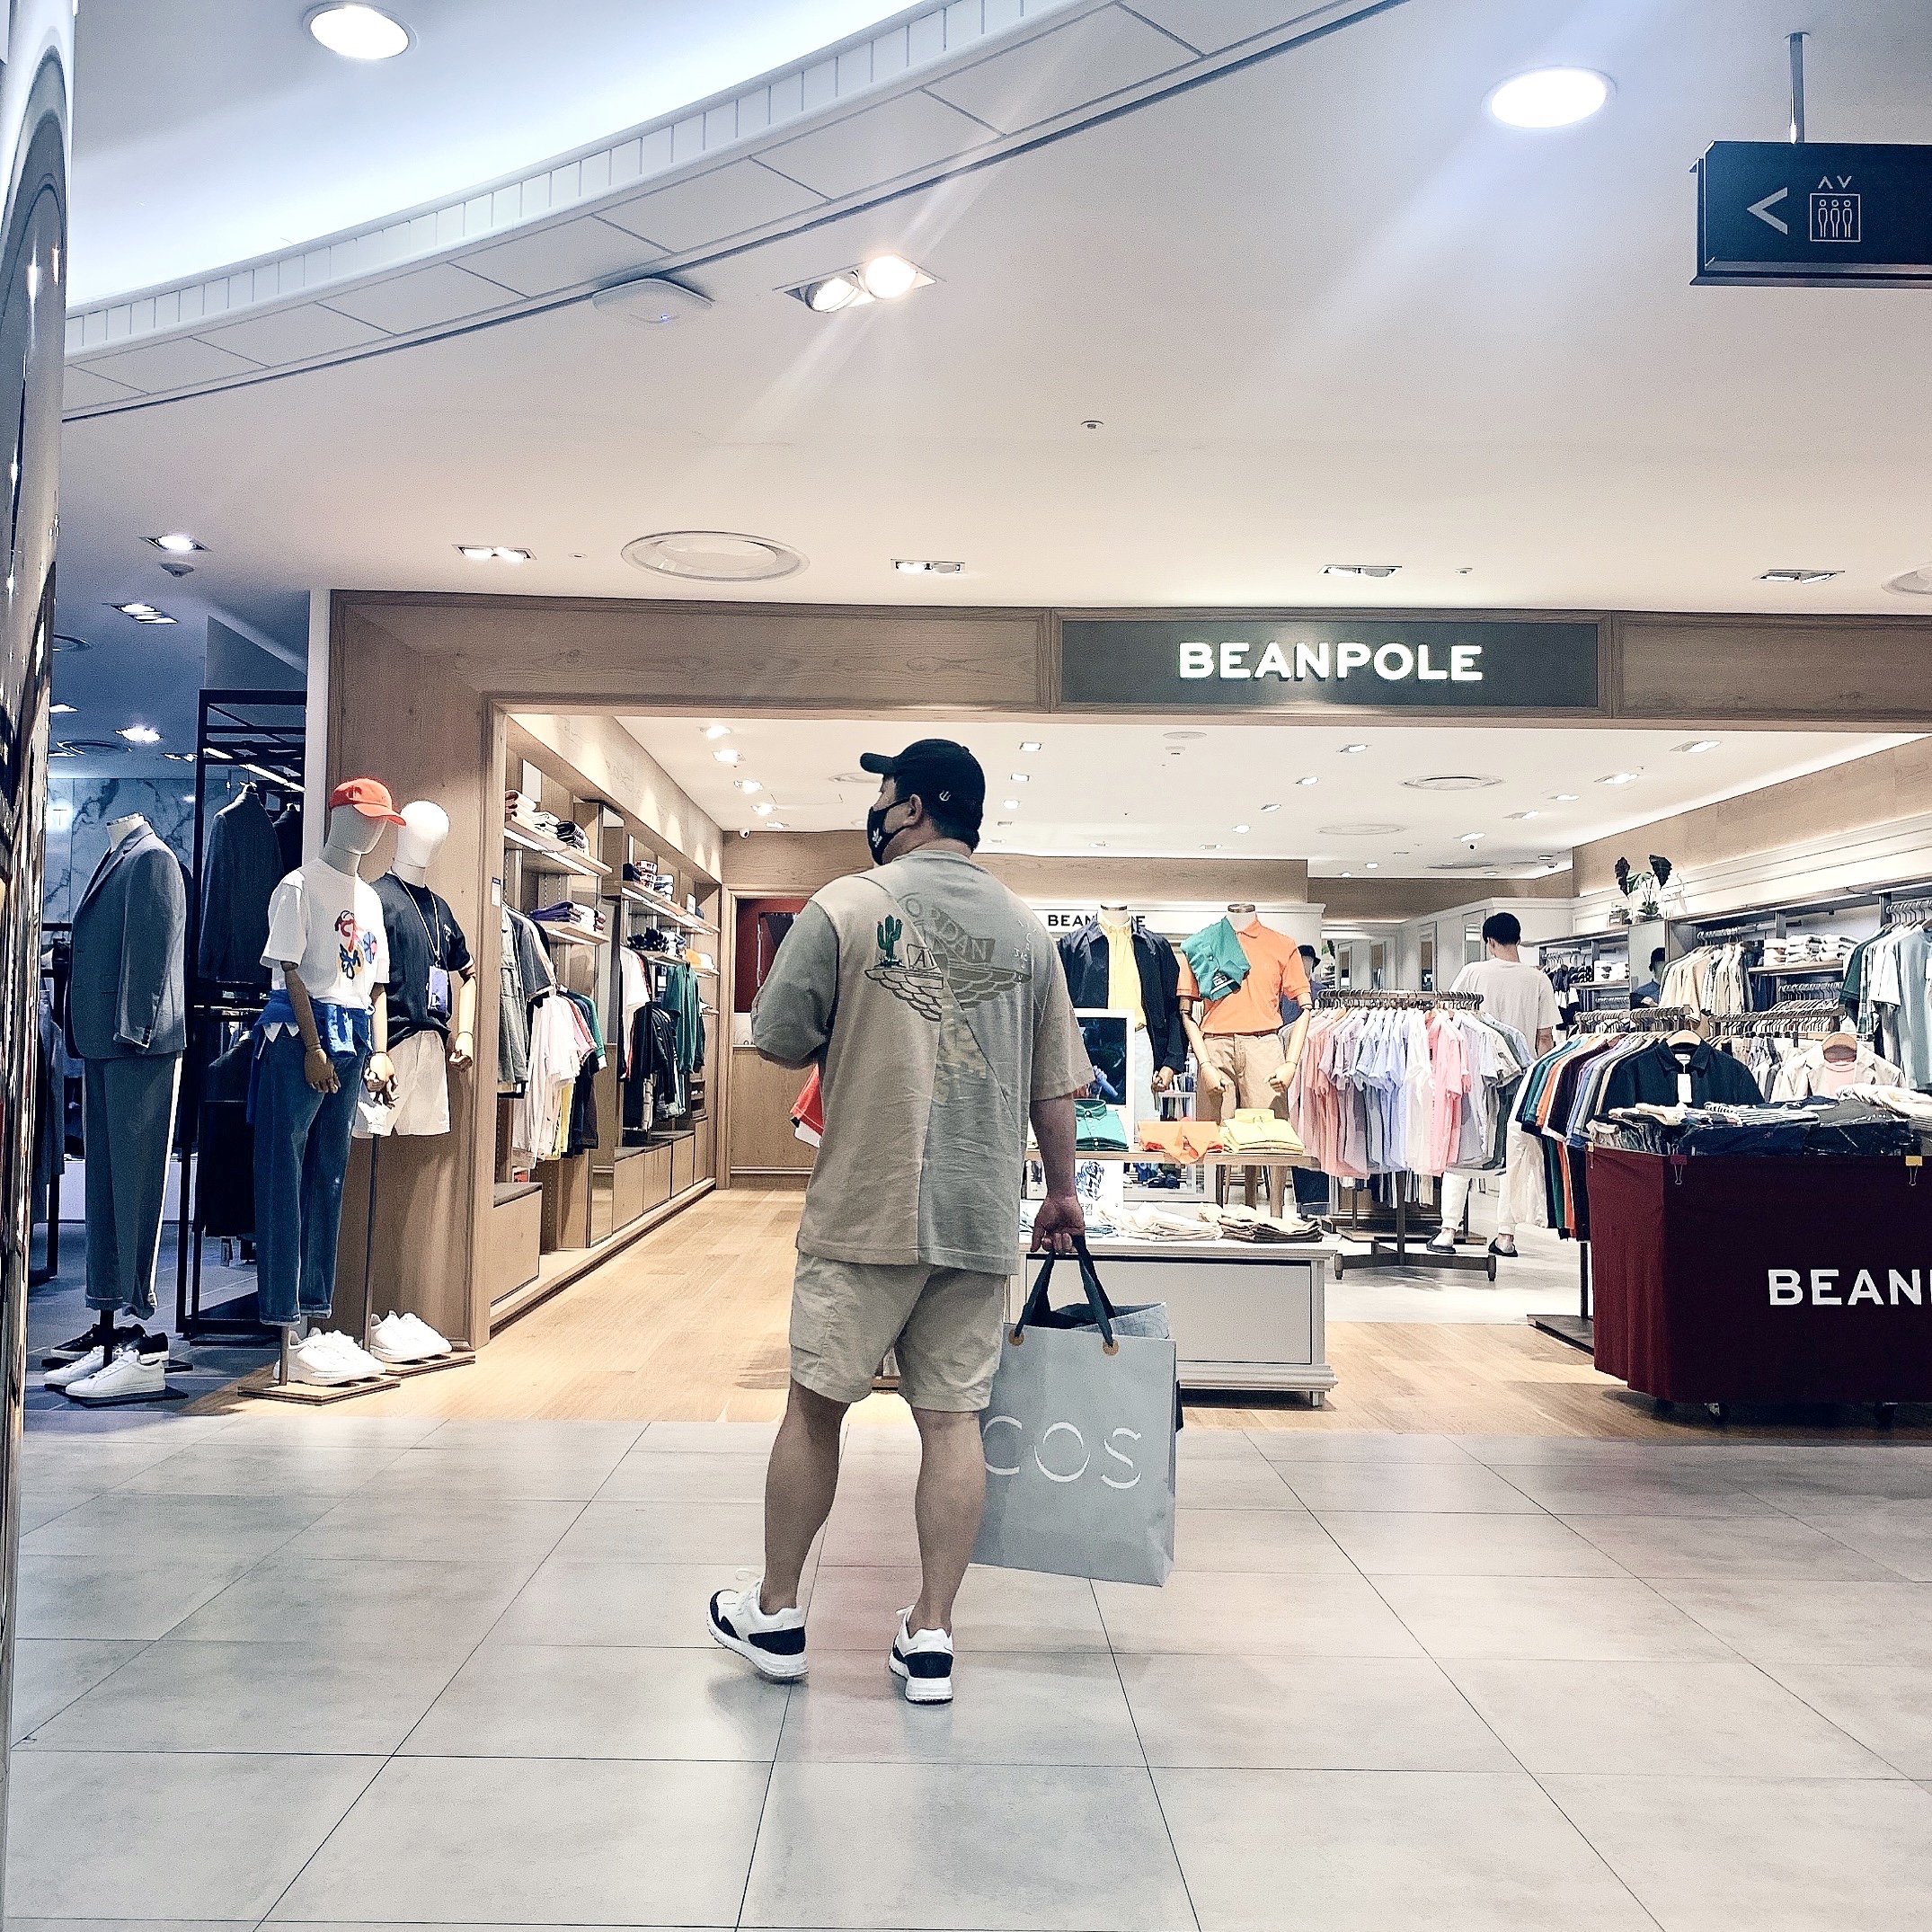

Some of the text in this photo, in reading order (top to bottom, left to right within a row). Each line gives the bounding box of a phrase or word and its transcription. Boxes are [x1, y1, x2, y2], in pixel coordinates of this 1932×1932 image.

[1178, 641, 1484, 681] BEANPOLE
[1768, 1268, 1932, 1306] BEAN
[982, 1414, 1142, 1490] COS
